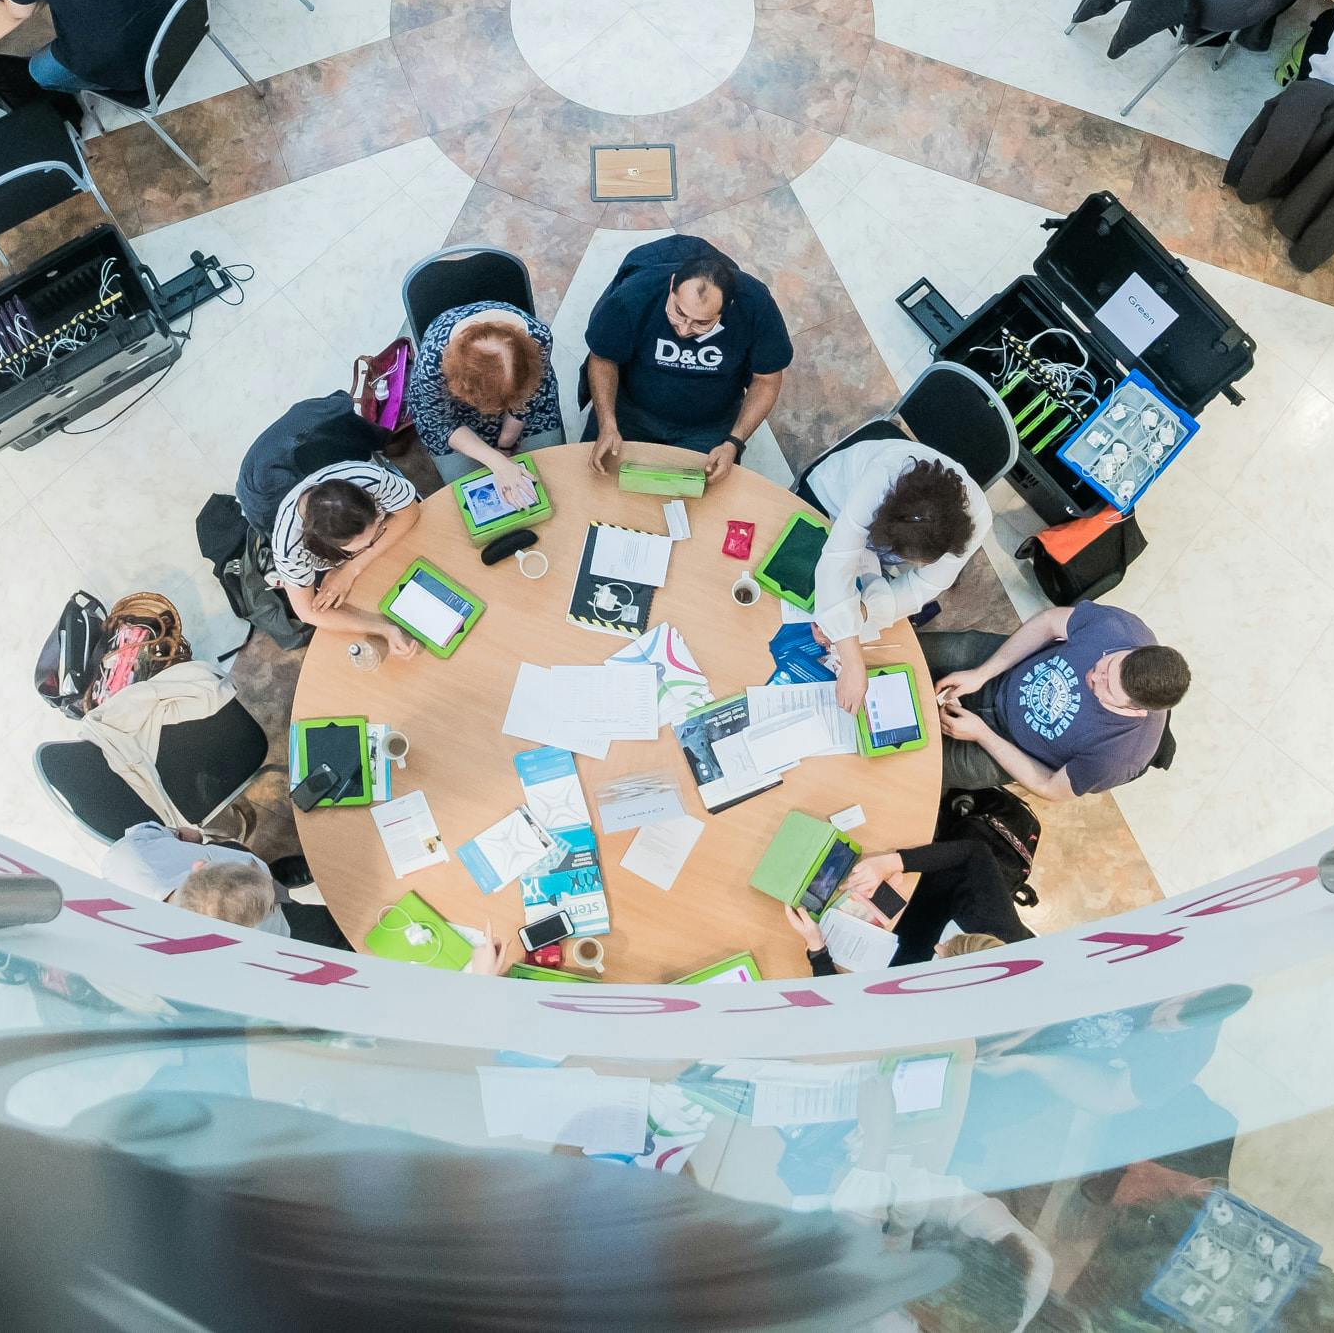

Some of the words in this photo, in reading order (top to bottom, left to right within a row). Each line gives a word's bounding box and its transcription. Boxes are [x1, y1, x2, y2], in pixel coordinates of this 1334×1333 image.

[1128, 294, 1157, 326] Green
[654, 337, 724, 368] D&G
[1047, 655, 1080, 688] ONCE
[1053, 692, 1082, 738] TRIED
